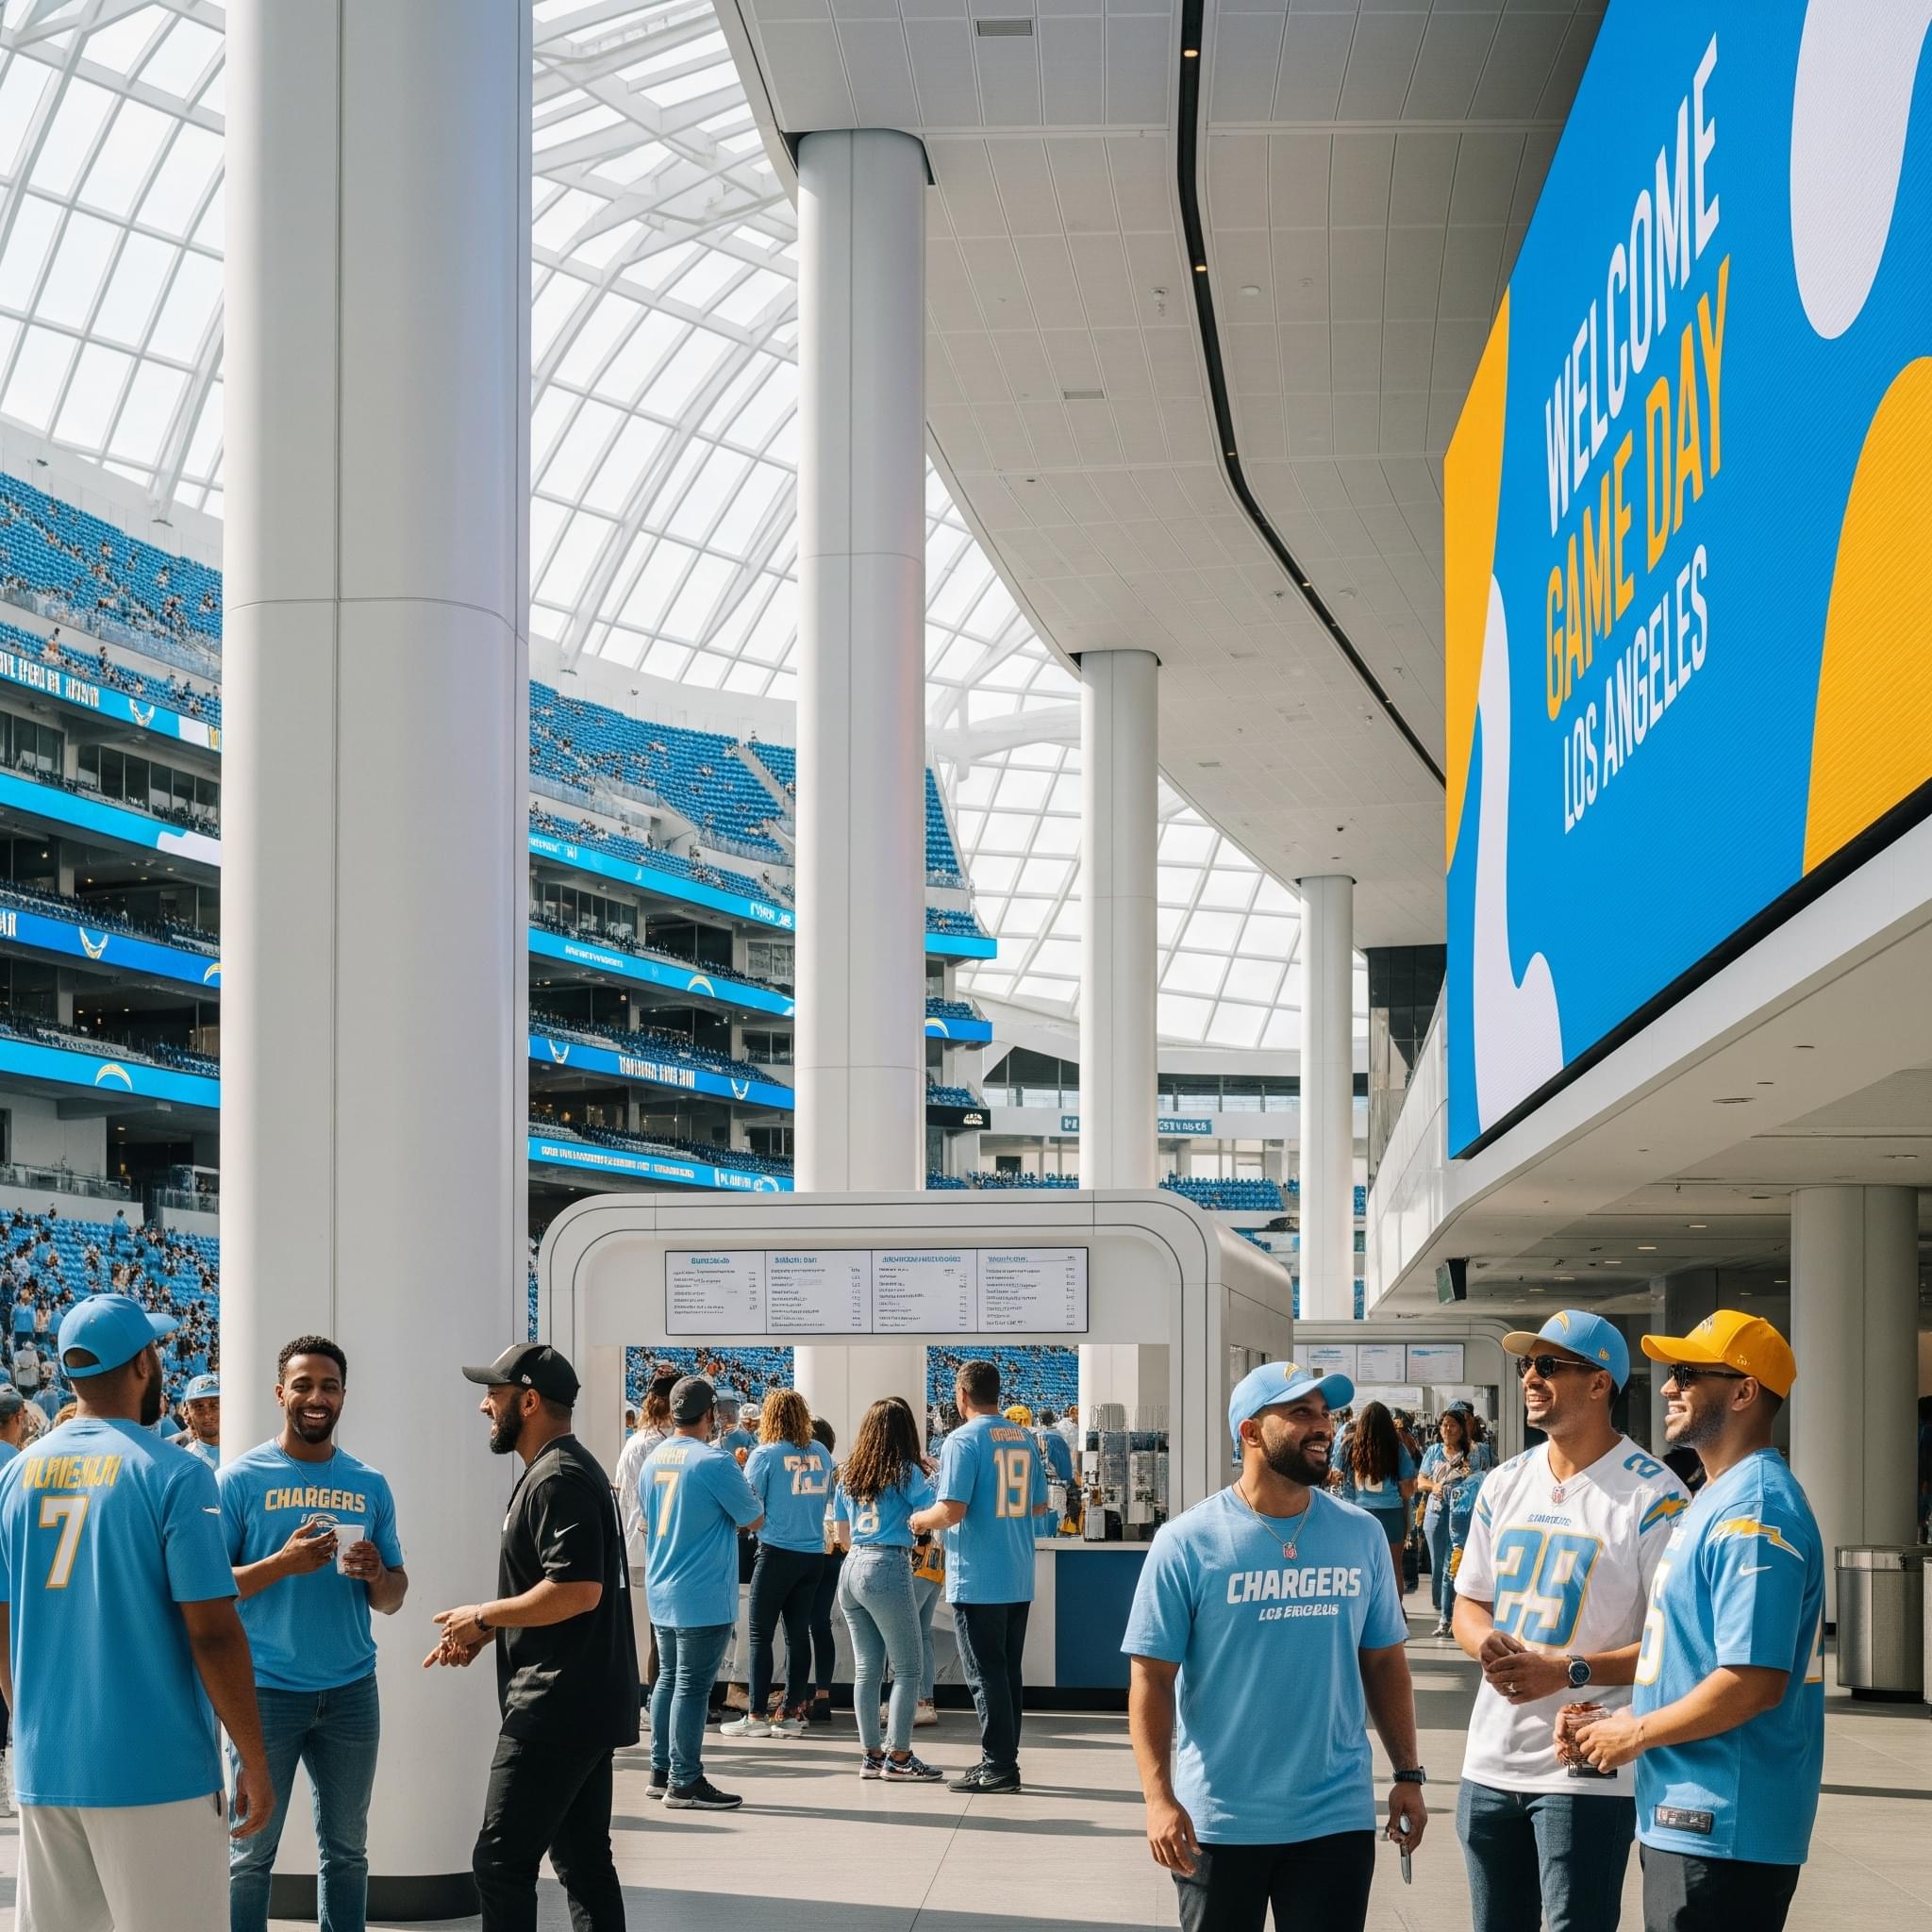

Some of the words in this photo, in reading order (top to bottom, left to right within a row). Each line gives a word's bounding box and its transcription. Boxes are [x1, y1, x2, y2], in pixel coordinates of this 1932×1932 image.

[1544, 32, 1720, 539] WELCOME
[1545, 430, 1634, 722] GAME
[1646, 254, 1730, 574] DAY
[1563, 712, 1598, 835] LOS
[1603, 543, 1707, 789] ANGELES
[264, 1486, 366, 1513] CHARGERS
[654, 1470, 680, 1538] 7
[993, 1448, 1031, 1518] 19
[39, 1494, 91, 1589] 7
[1226, 1567, 1362, 1605] CHARGERS
[1493, 1525, 1603, 1649] 29
